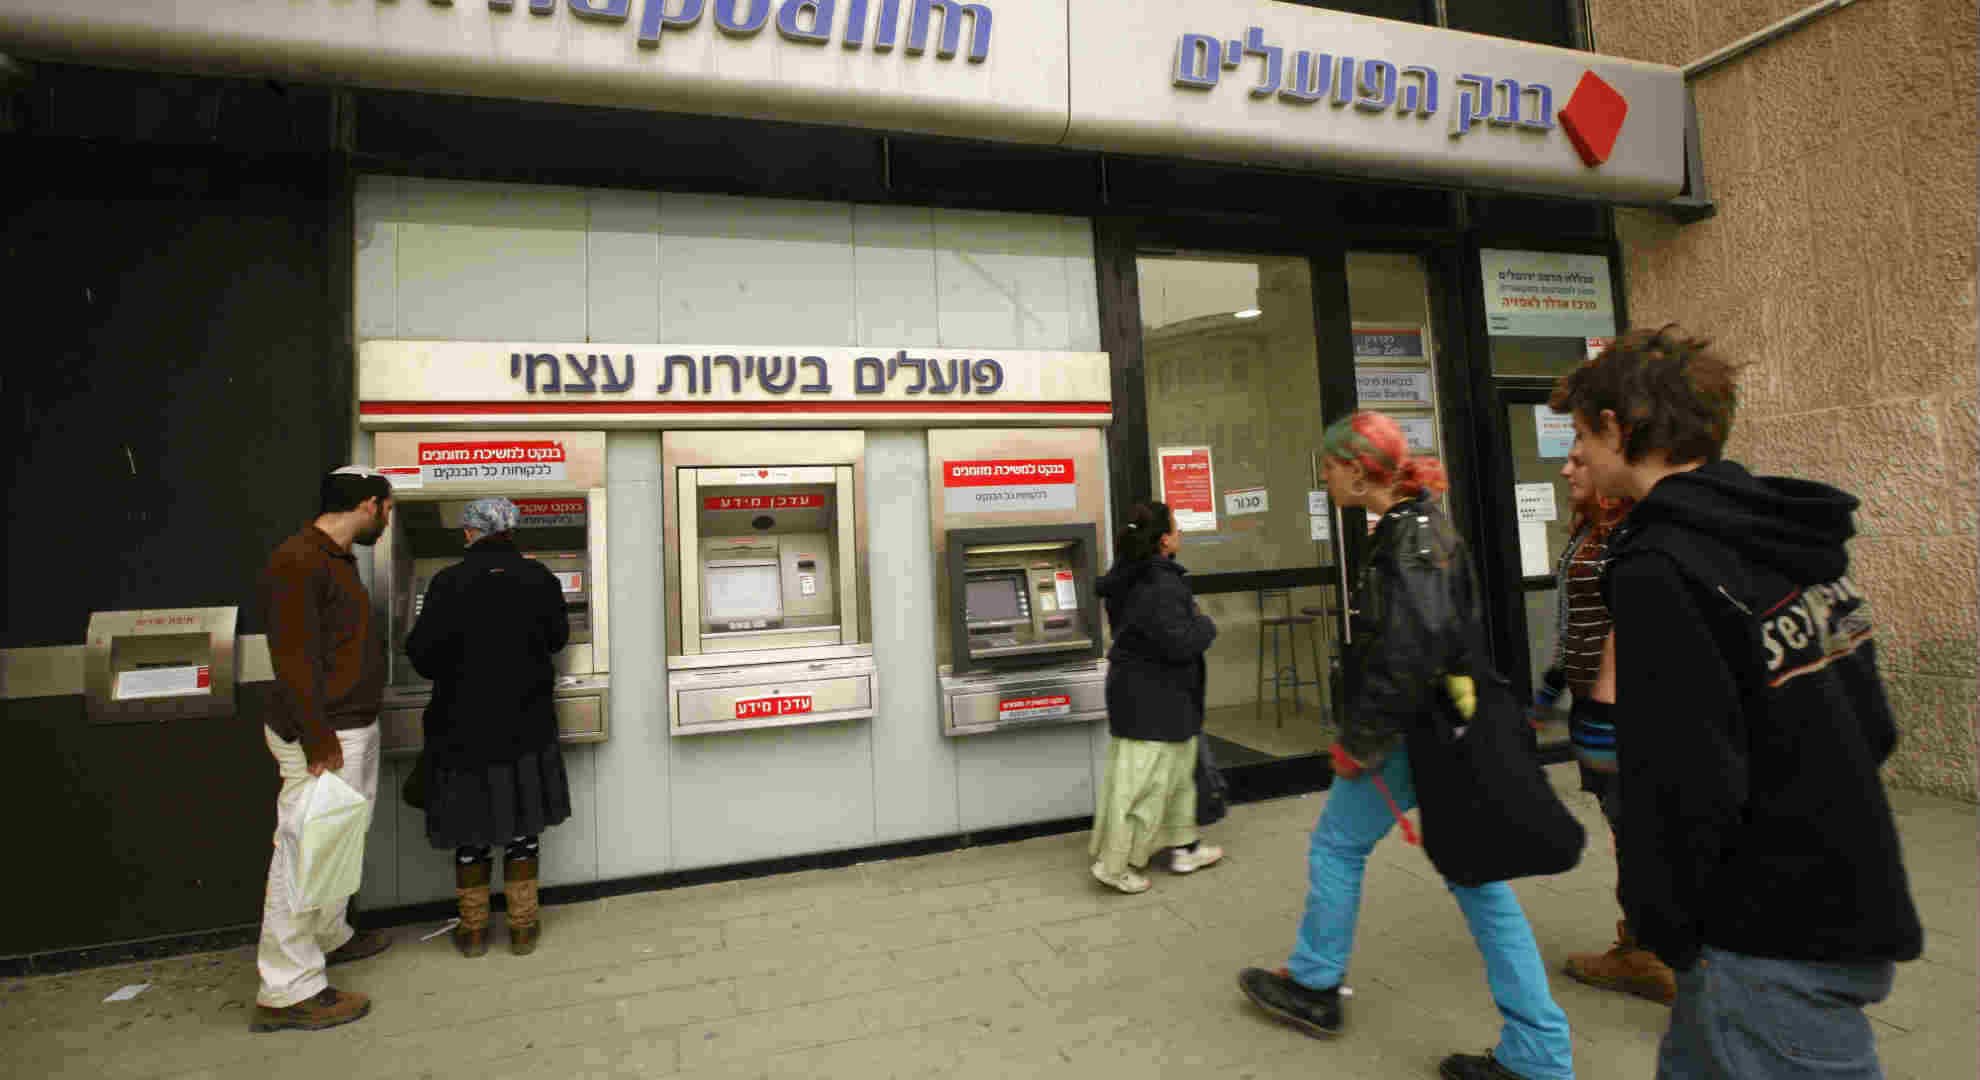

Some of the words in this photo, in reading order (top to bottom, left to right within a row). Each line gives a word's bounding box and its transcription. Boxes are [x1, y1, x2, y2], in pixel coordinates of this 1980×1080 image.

[1176, 26, 1439, 112] הפועלים
[1453, 72, 1556, 137] בנק
[510, 352, 636, 394] עצמי
[657, 354, 832, 395] בשירות
[853, 350, 1005, 395] פועלים
[423, 449, 470, 462] מזומנים
[473, 446, 525, 460] למשיכת
[528, 447, 561, 461] בנקט
[433, 466, 478, 480] הבנקים
[481, 465, 498, 477] כל
[501, 464, 552, 478] ללקוחות
[951, 465, 992, 477] מזומנים
[994, 463, 1036, 475] למשיכת
[1038, 463, 1065, 476] בנקט
[720, 497, 761, 508] מידע
[769, 495, 809, 509] עדכן
[1232, 496, 1261, 510] סגור
[737, 701, 772, 714] מידע
[777, 696, 810, 716] עדכן
